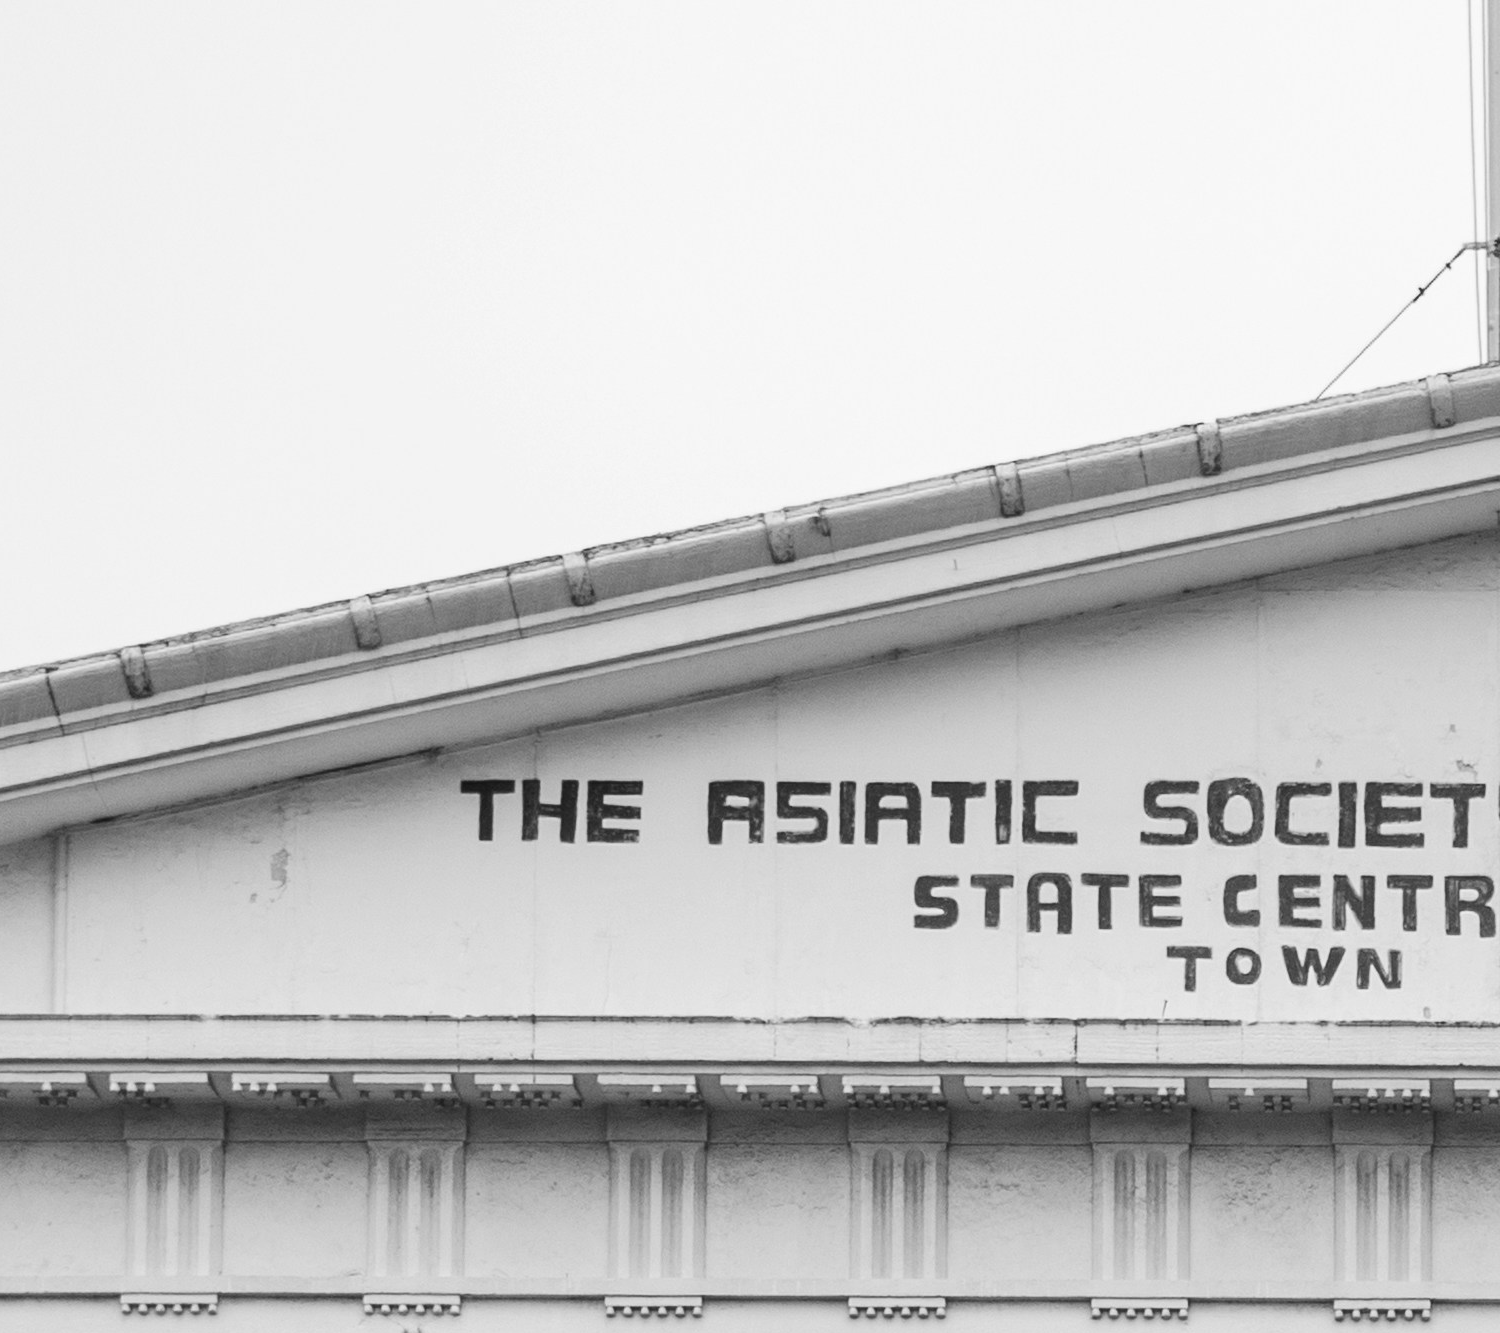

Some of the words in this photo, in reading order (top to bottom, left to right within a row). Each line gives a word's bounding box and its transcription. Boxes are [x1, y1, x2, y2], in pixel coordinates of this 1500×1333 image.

[459, 778, 644, 844] THE
[707, 779, 1079, 845] ASIATIC
[913, 872, 1183, 935] STATE
[1166, 945, 1402, 992] TOWN
